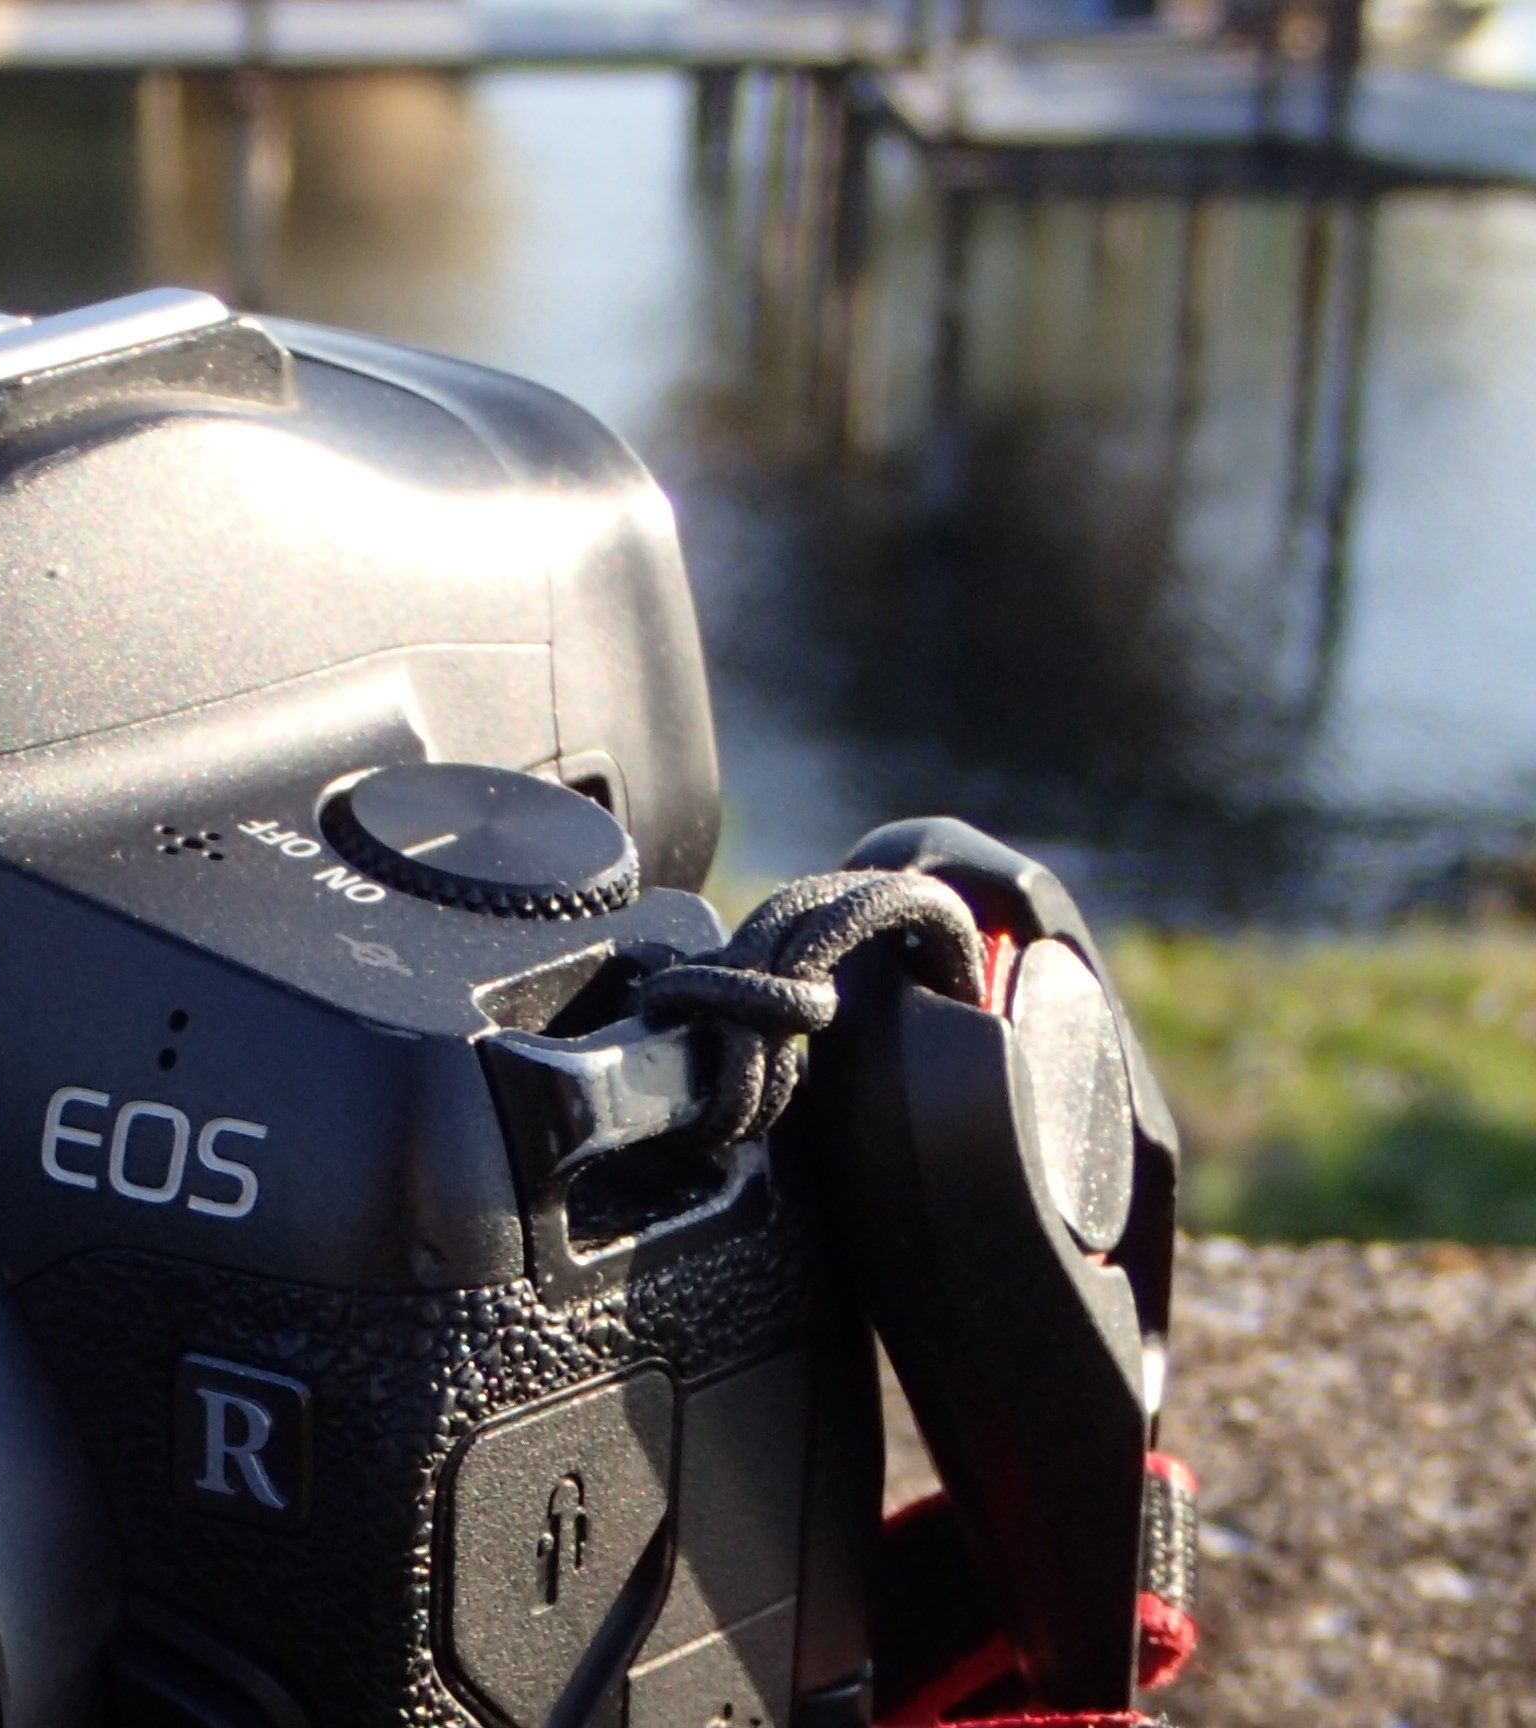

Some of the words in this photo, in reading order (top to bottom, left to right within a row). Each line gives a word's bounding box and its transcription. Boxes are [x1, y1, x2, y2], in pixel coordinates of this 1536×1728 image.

[237, 820, 322, 858] OFF
[313, 866, 387, 903] ON
[41, 1086, 269, 1219] EOS
[195, 1386, 286, 1510] R
